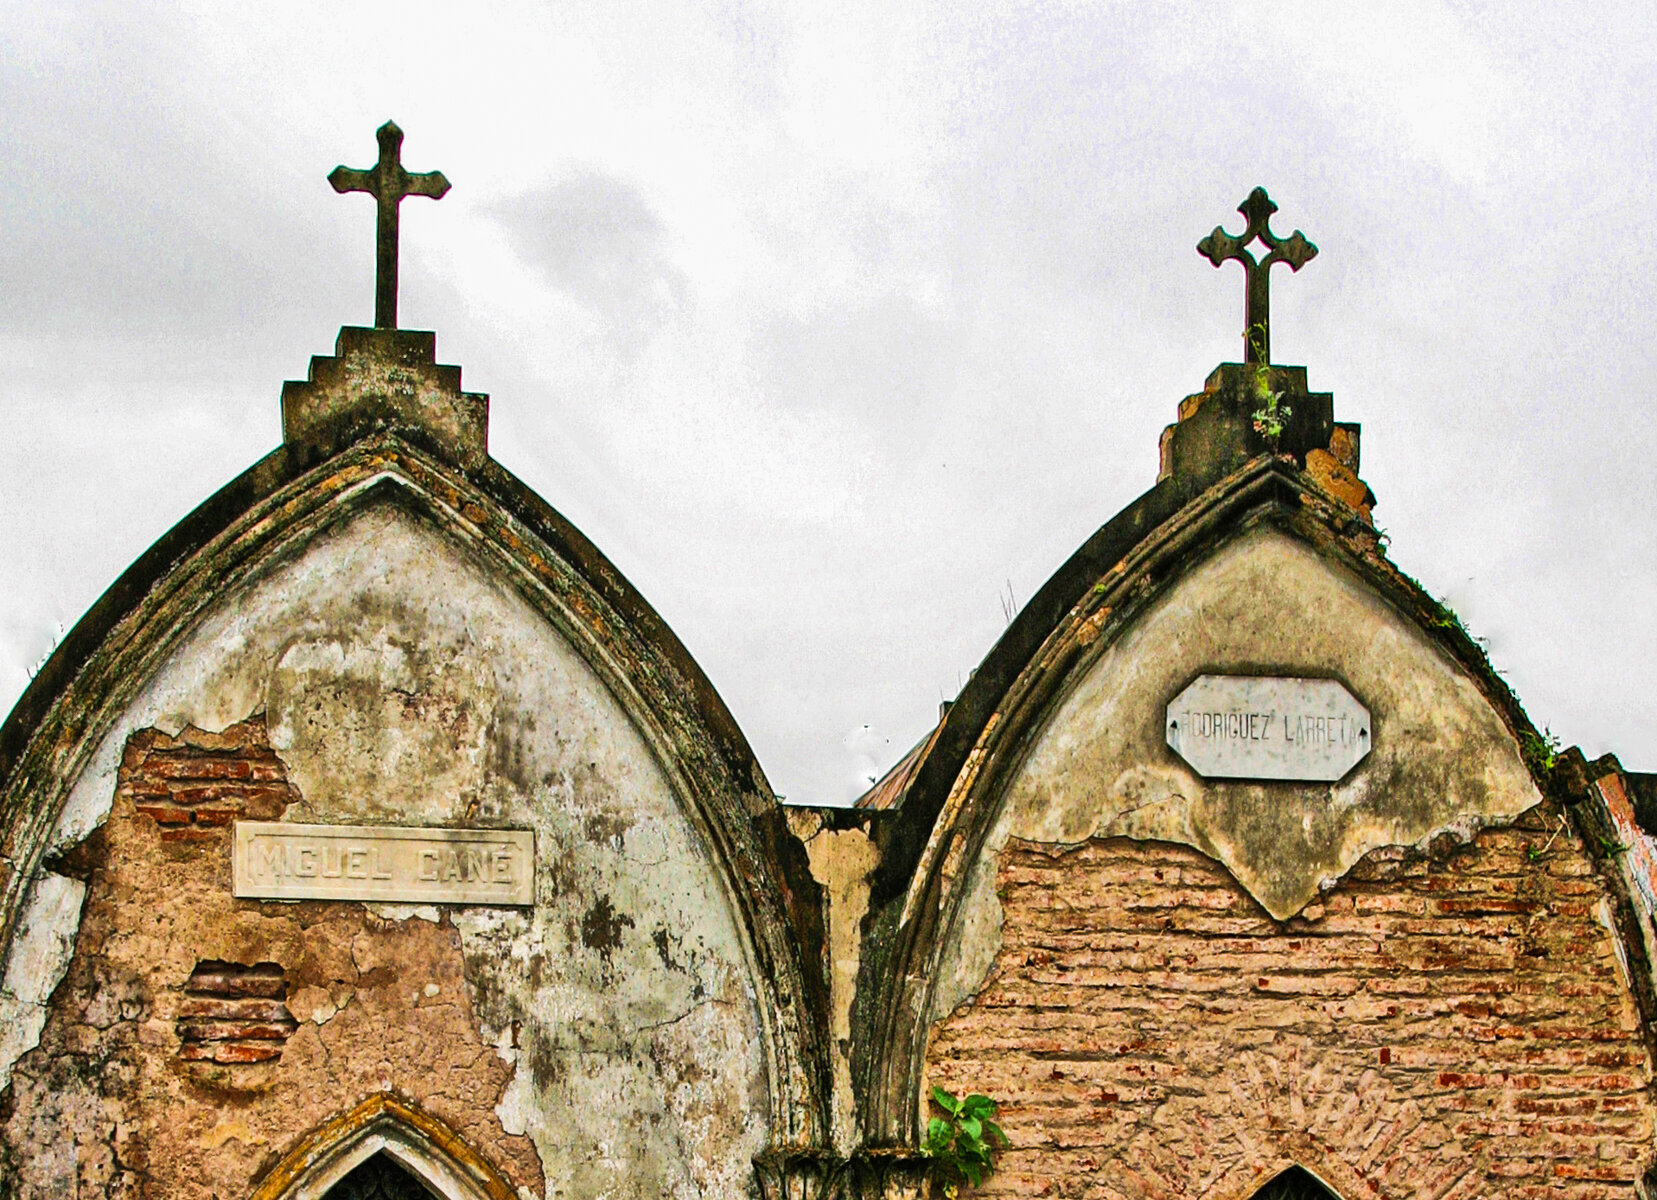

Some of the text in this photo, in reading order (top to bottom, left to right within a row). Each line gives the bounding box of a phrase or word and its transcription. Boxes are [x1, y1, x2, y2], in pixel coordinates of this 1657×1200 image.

[1180, 711, 1357, 744] RODRIGUEZ LARRETA
[256, 844, 393, 881] MIGUEL
